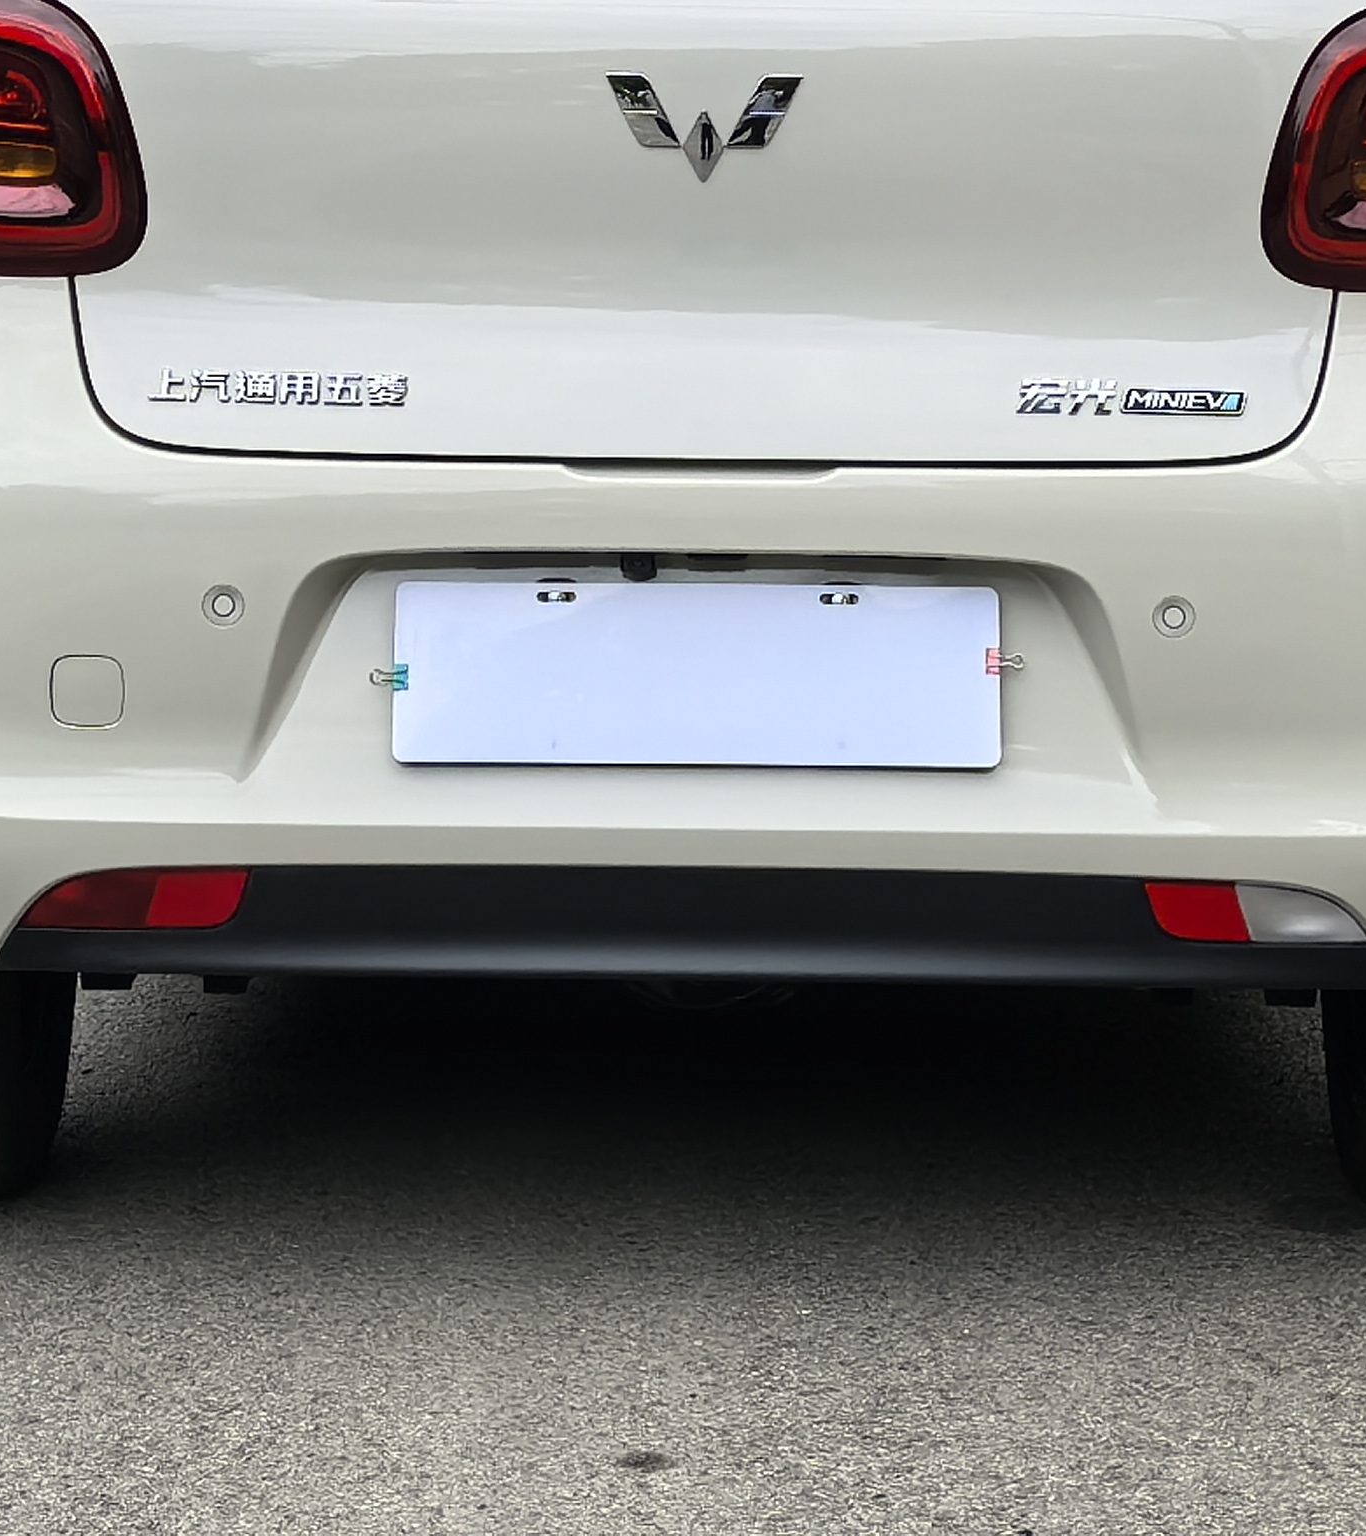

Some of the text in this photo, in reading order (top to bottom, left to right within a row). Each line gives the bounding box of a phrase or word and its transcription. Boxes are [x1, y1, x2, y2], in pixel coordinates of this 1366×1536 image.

[147, 366, 409, 406] 上汽通用五菱
[1015, 376, 1227, 415] 宏光 MINIEV
